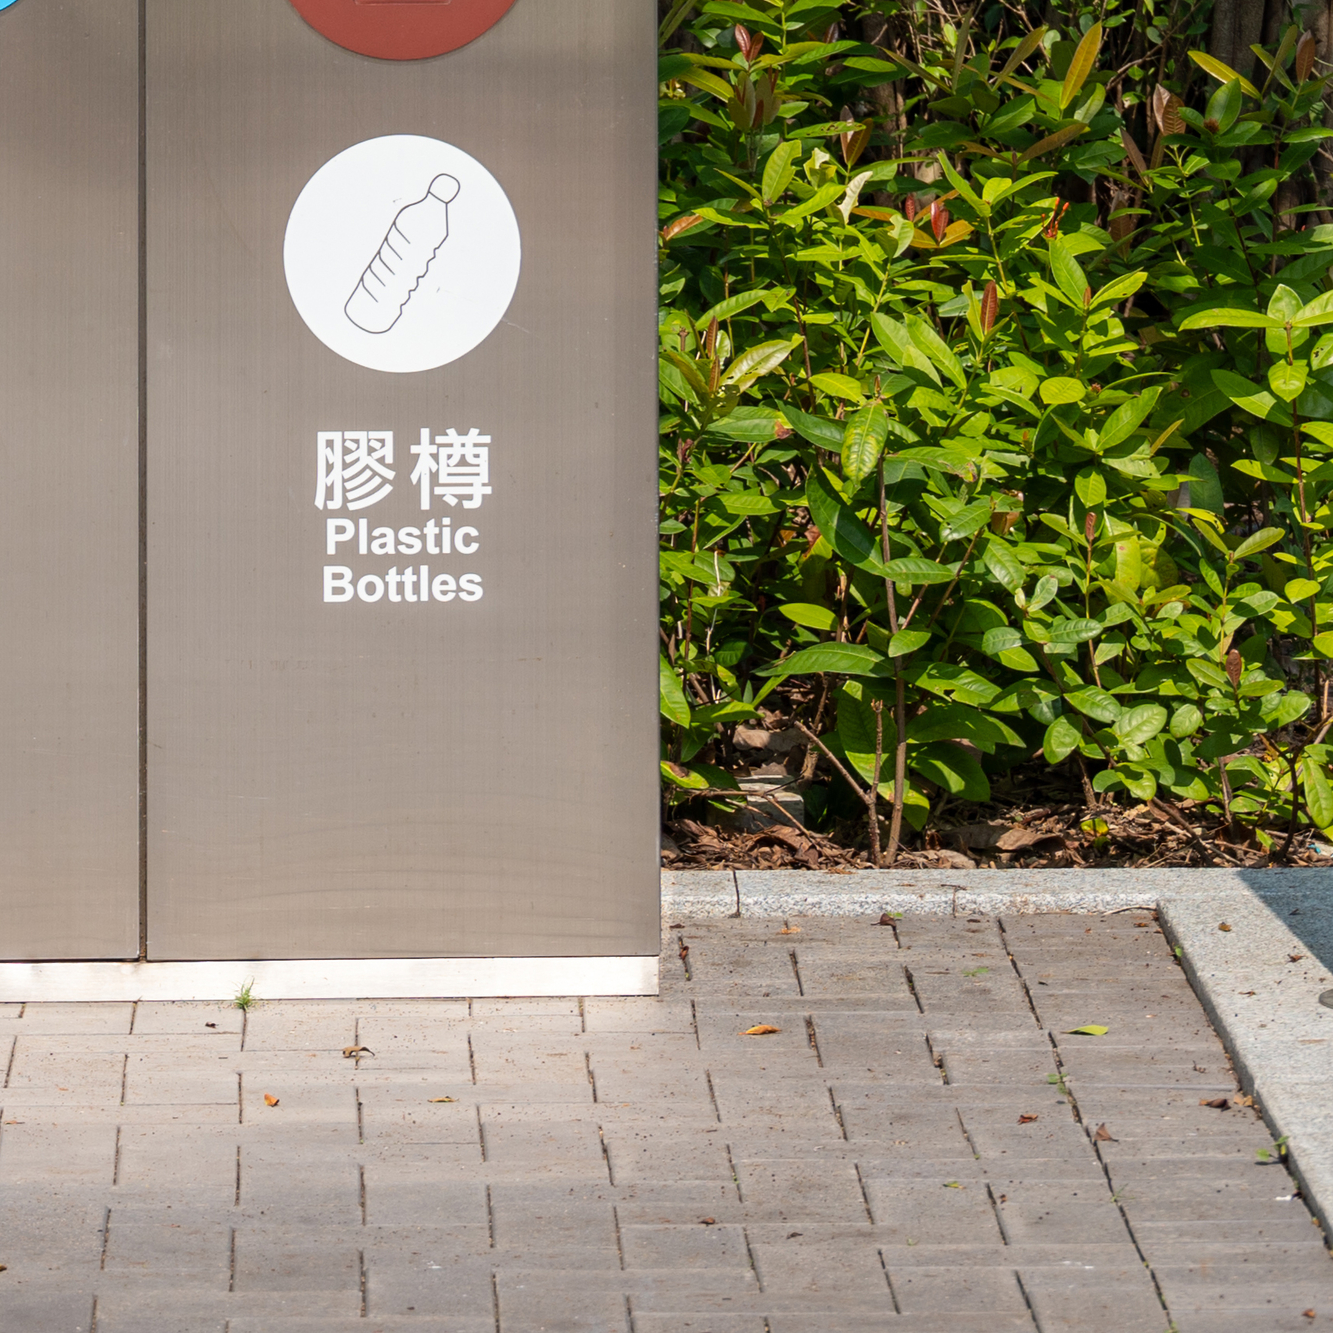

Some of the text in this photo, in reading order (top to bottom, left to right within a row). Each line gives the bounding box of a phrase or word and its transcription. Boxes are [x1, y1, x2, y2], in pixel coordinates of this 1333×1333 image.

[314, 427, 493, 511] 膠樽
[326, 517, 480, 555] Plastic
[323, 564, 484, 603] Bottles
